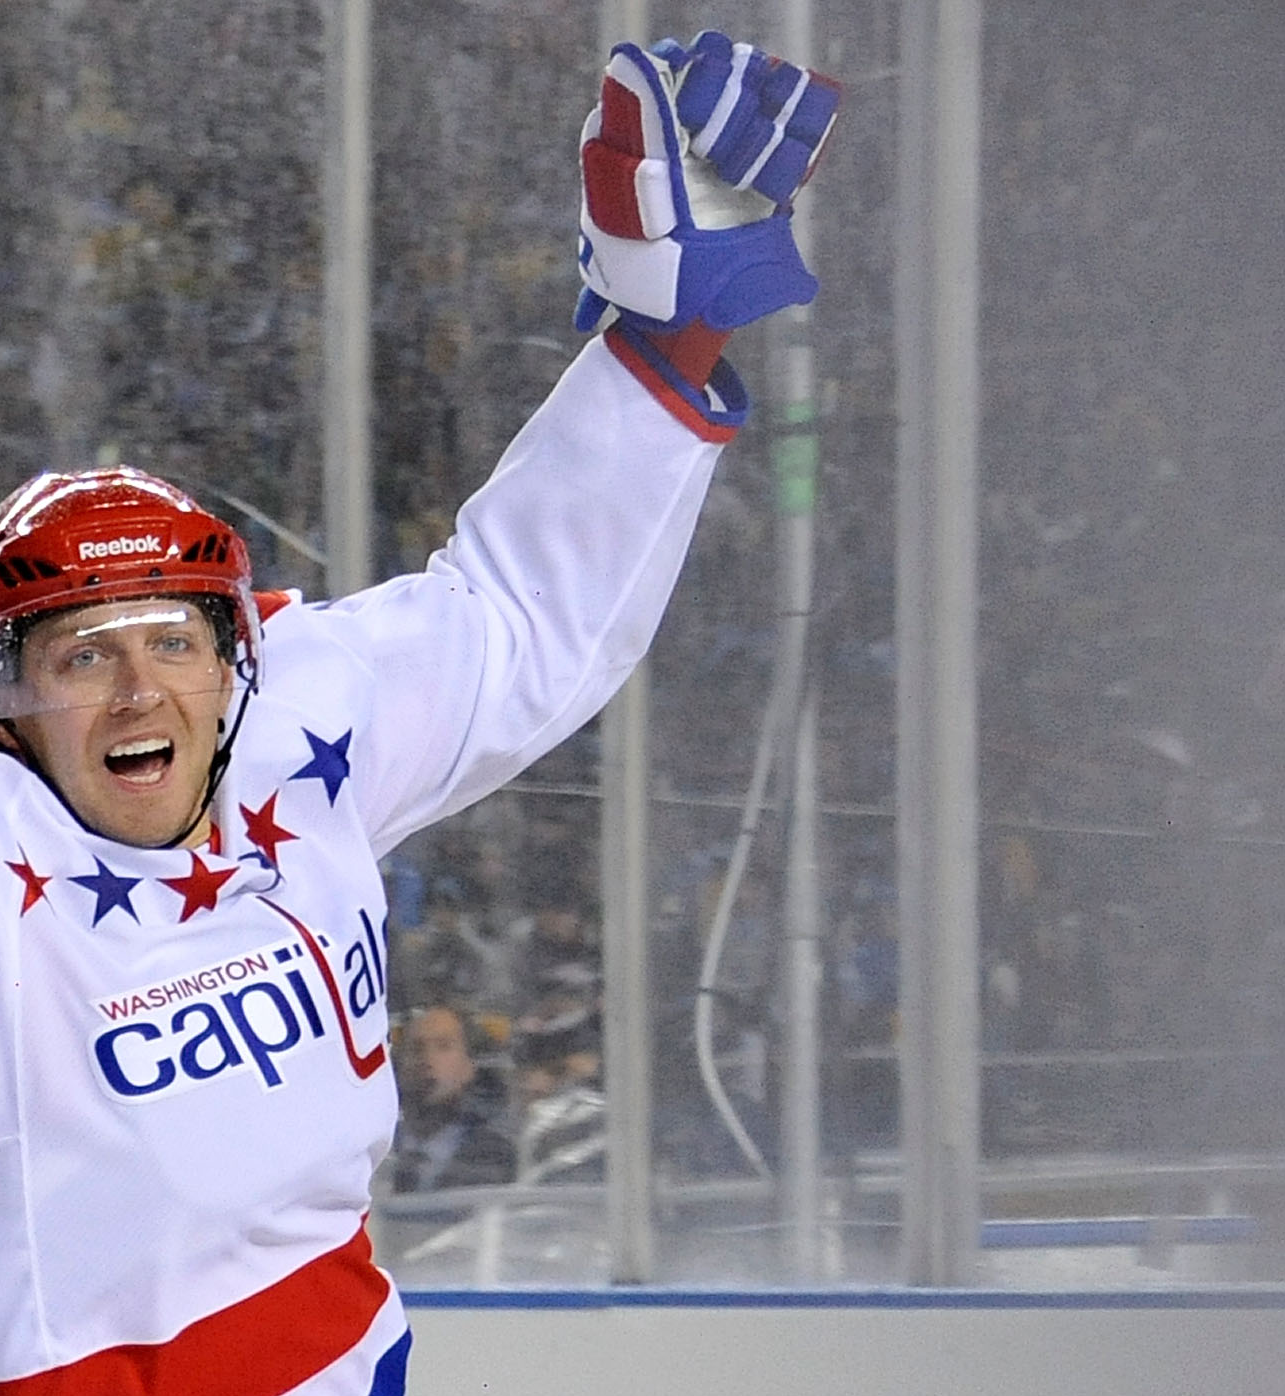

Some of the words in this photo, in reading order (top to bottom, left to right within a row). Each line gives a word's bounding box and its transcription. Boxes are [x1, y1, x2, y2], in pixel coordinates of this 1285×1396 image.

[78, 534, 162, 560] Reebok
[94, 895, 388, 1096] capital
[99, 953, 269, 1021] WASHINGTON
